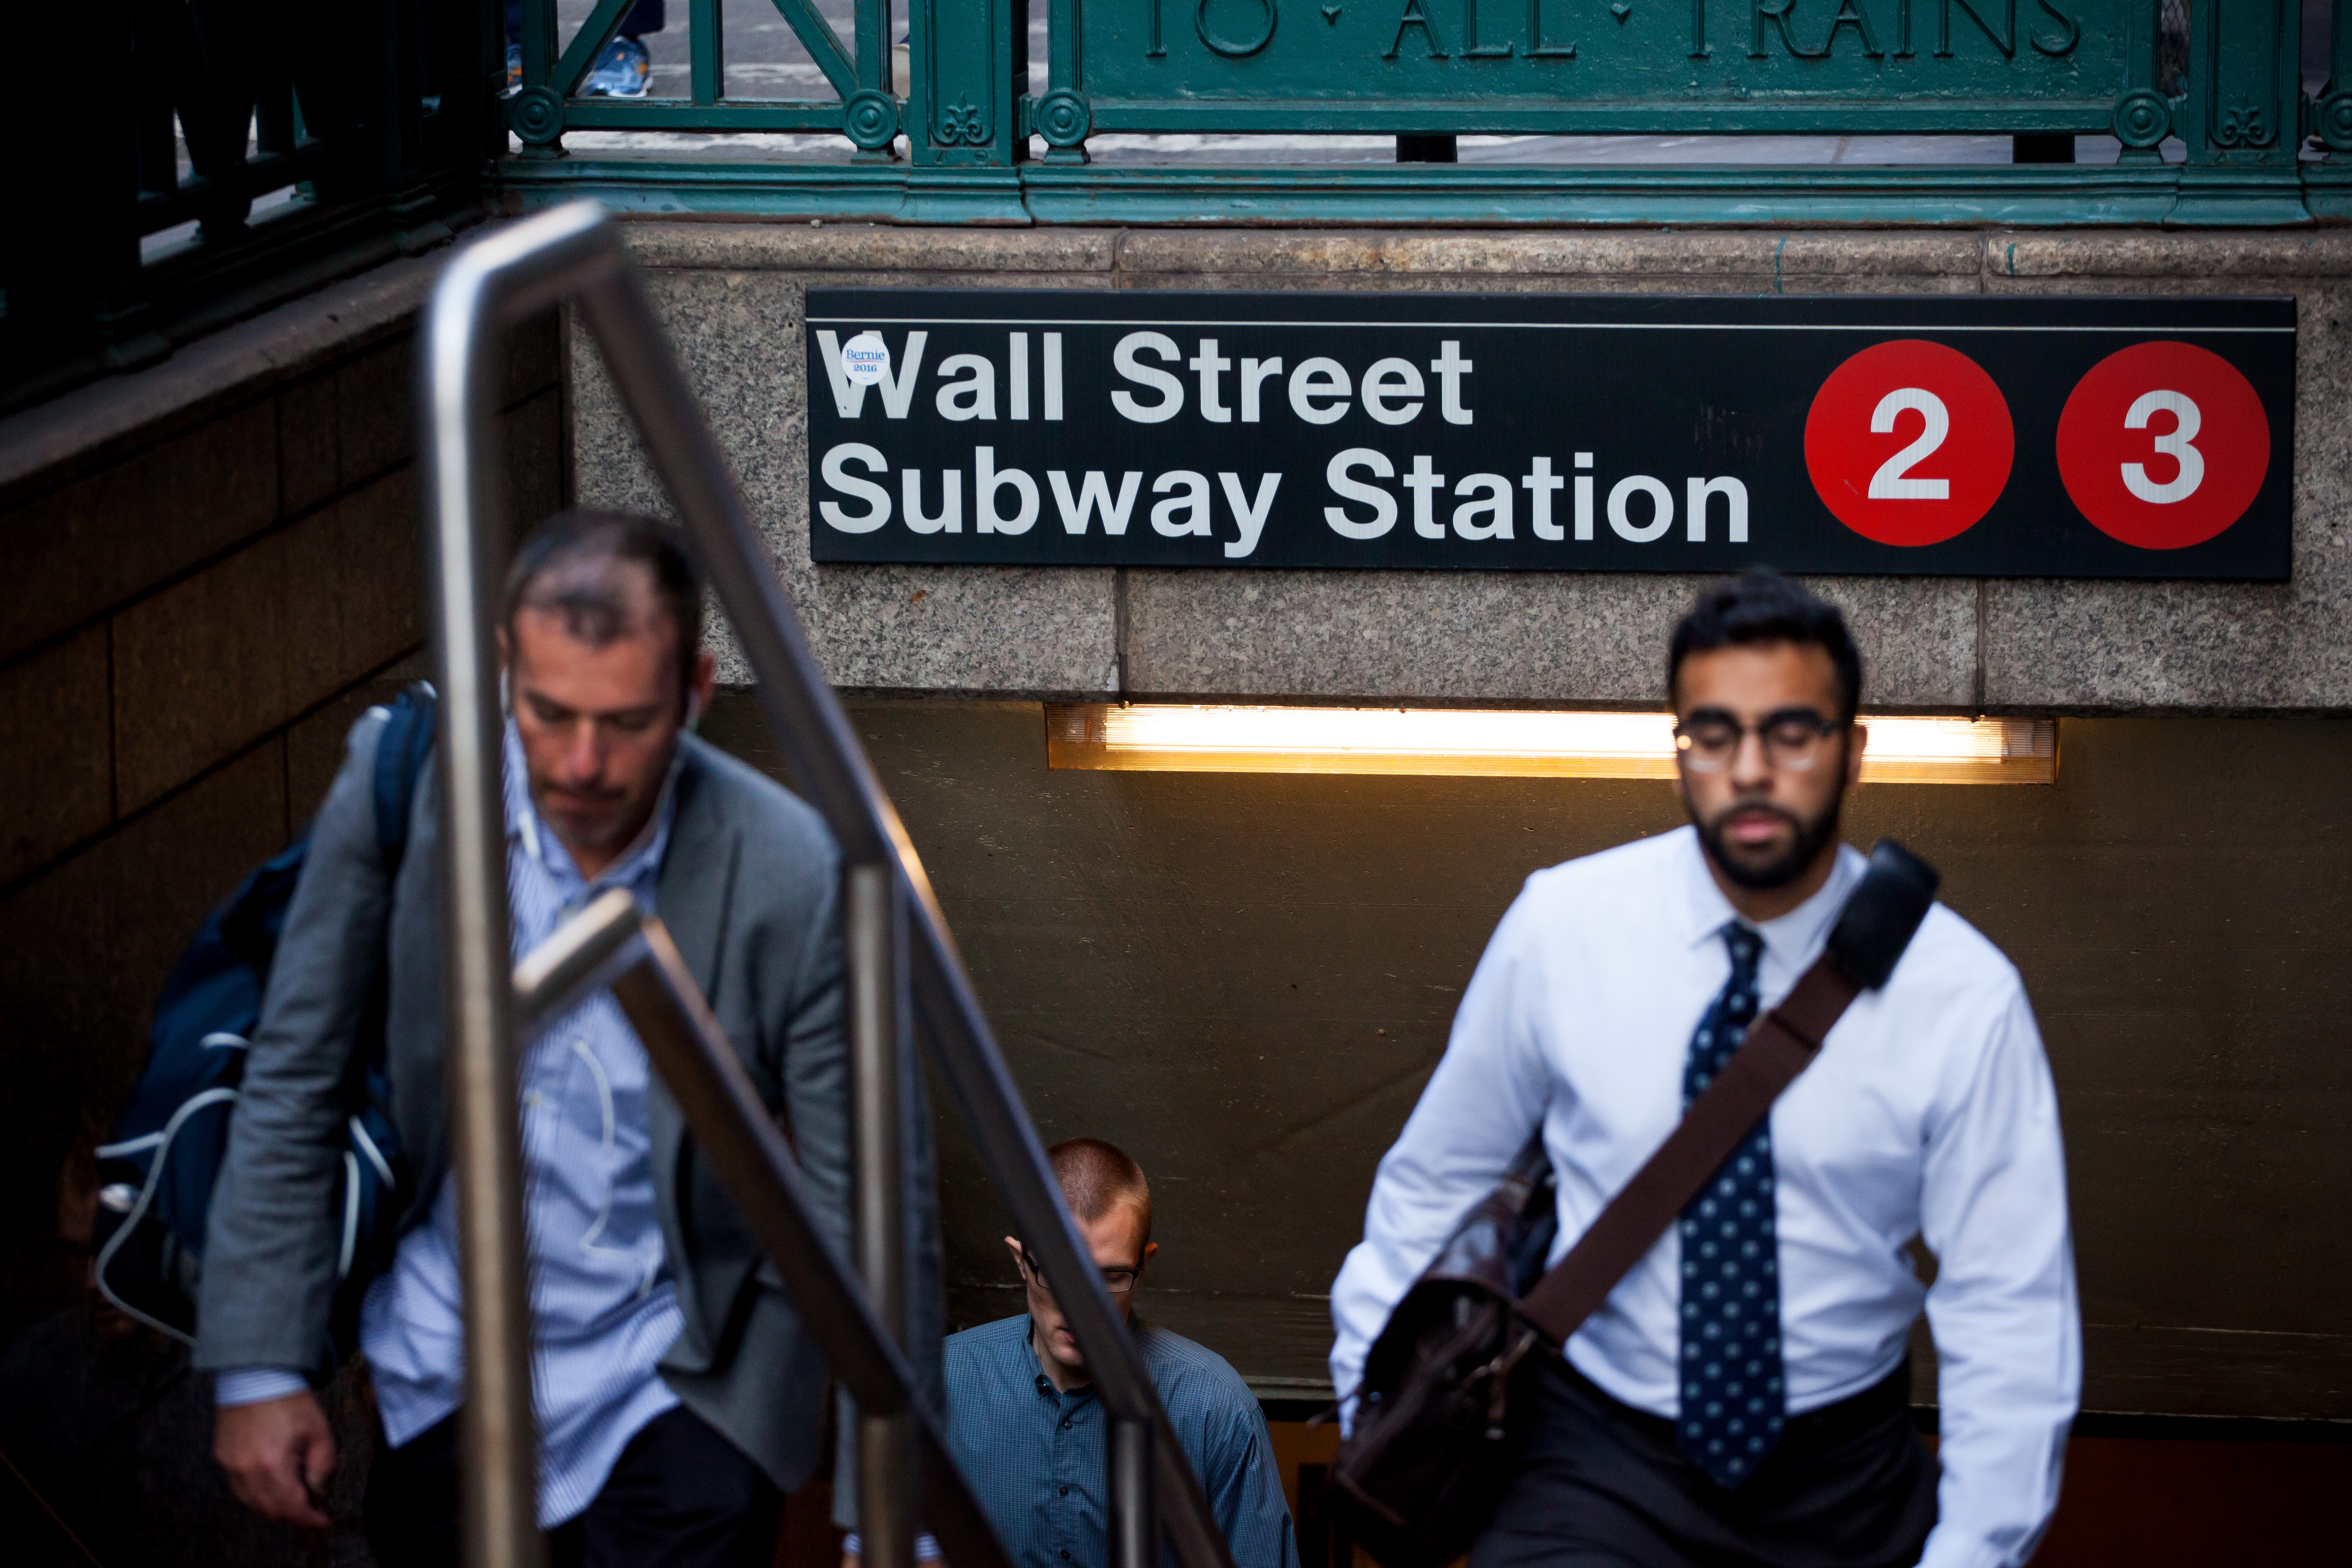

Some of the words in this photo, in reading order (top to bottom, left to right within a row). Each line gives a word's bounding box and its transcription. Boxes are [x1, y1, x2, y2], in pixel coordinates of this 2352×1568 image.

[1381, 0, 1577, 59] ALL
[815, 330, 1063, 421] Wall
[1111, 331, 1473, 425] Street
[846, 349, 885, 360] Bernie
[1868, 387, 1950, 500] 2
[2121, 389, 2205, 504] 3
[819, 442, 1282, 558] Subway
[1324, 448, 1748, 542] Station
